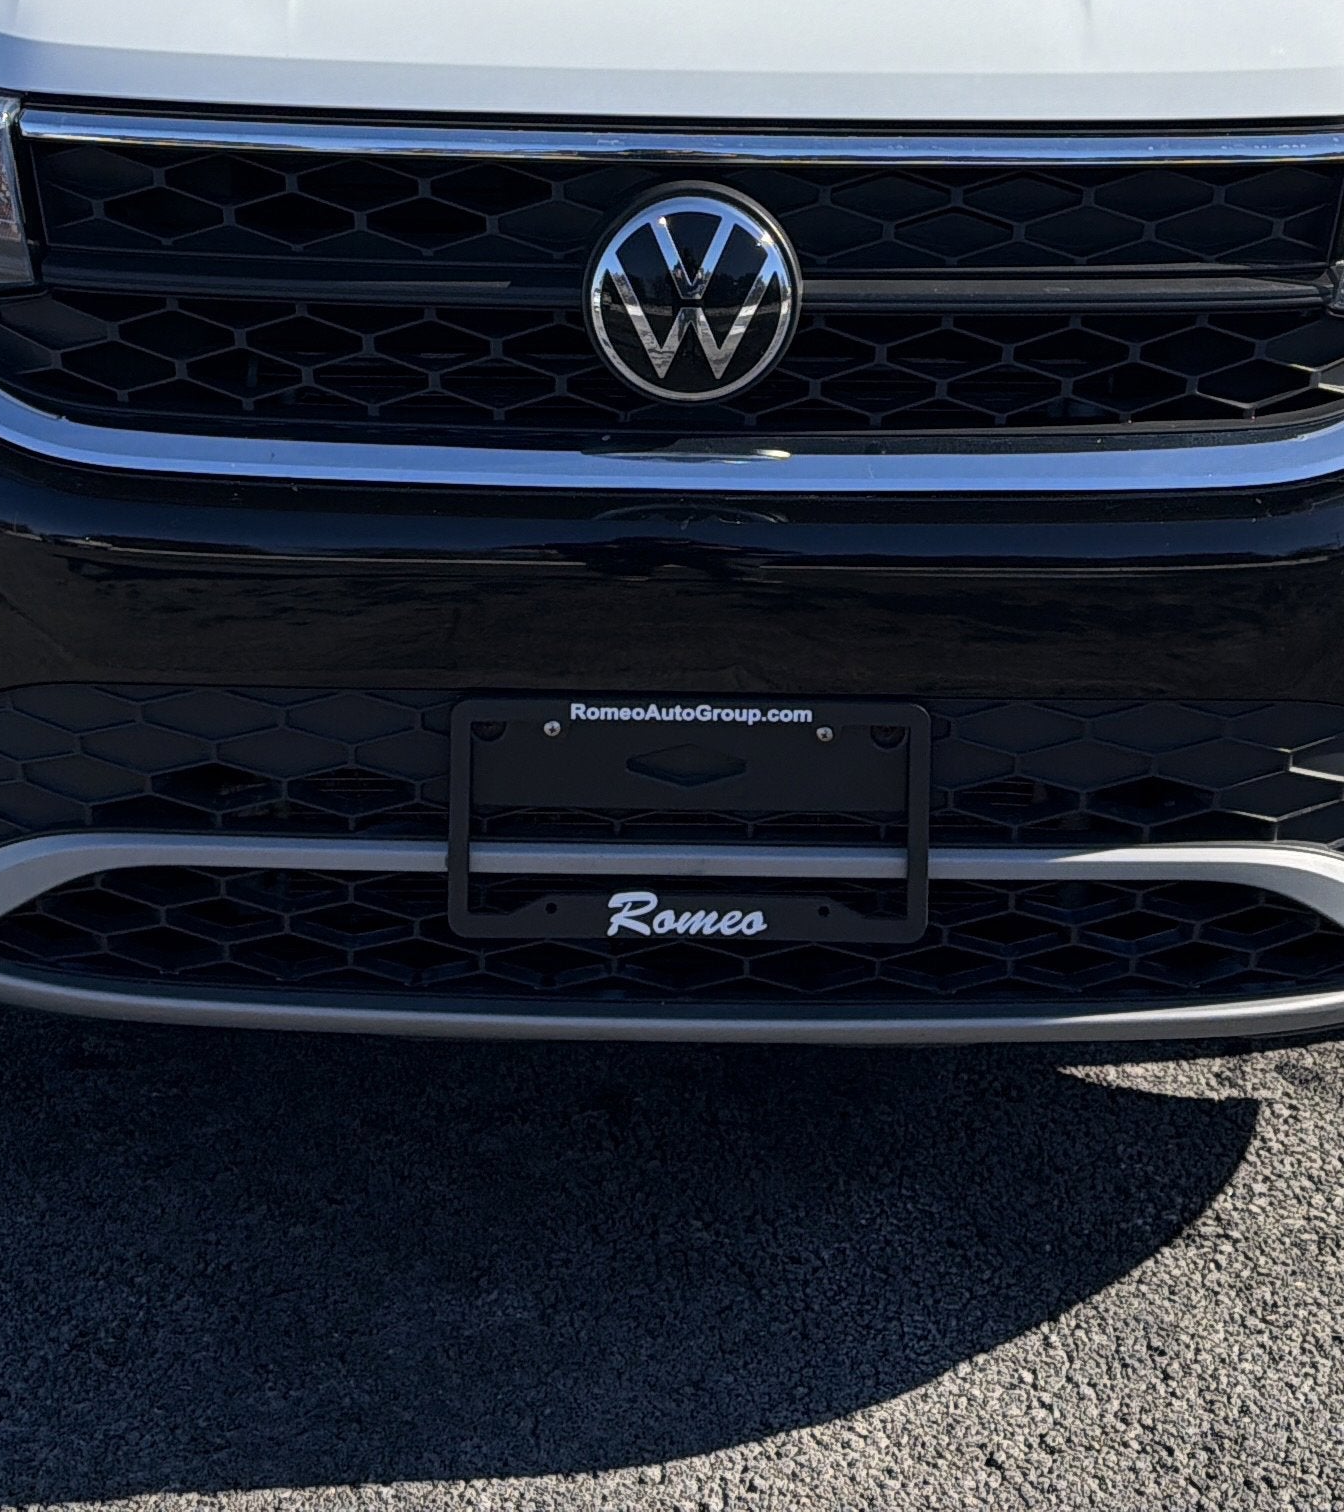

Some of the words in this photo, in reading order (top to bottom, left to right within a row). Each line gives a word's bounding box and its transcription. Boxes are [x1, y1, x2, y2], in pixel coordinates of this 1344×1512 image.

[591, 196, 792, 402] VW
[570, 703, 813, 725] RomeoAutoGroup.com
[606, 891, 768, 937] Romeo
